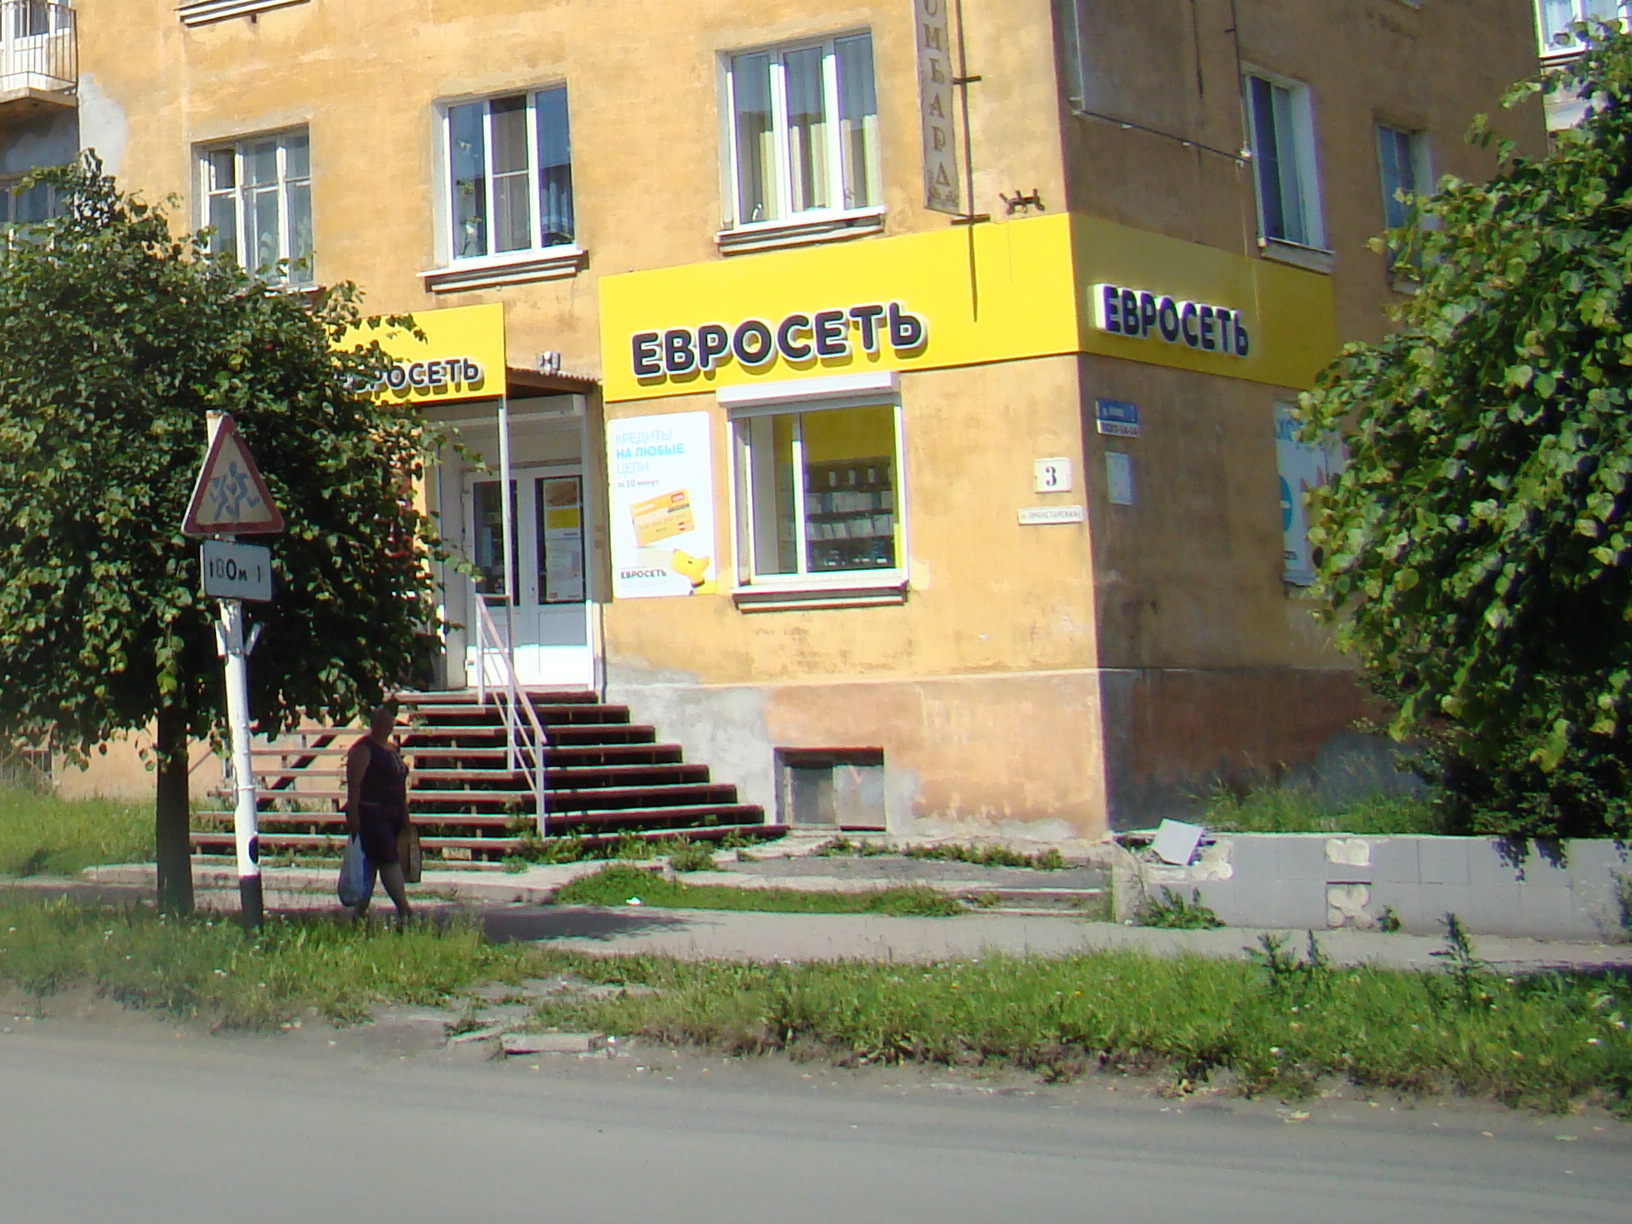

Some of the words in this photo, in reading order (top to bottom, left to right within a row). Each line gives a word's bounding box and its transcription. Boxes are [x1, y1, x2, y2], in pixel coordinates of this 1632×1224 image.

[1103, 284, 1249, 357] ЕВРОСЕТЬ
[631, 302, 923, 377] ЕВРОСЕТЬ
[615, 429, 672, 445] КРЕДИТЫ
[616, 447, 632, 460] НА
[635, 443, 685, 458] ЛЮБЫЕ
[616, 462, 650, 476] ЦЕЛИ
[1045, 466, 1058, 487] 3
[626, 479, 636, 488] 10
[620, 569, 667, 579] ЕВРОСЕТЬ
